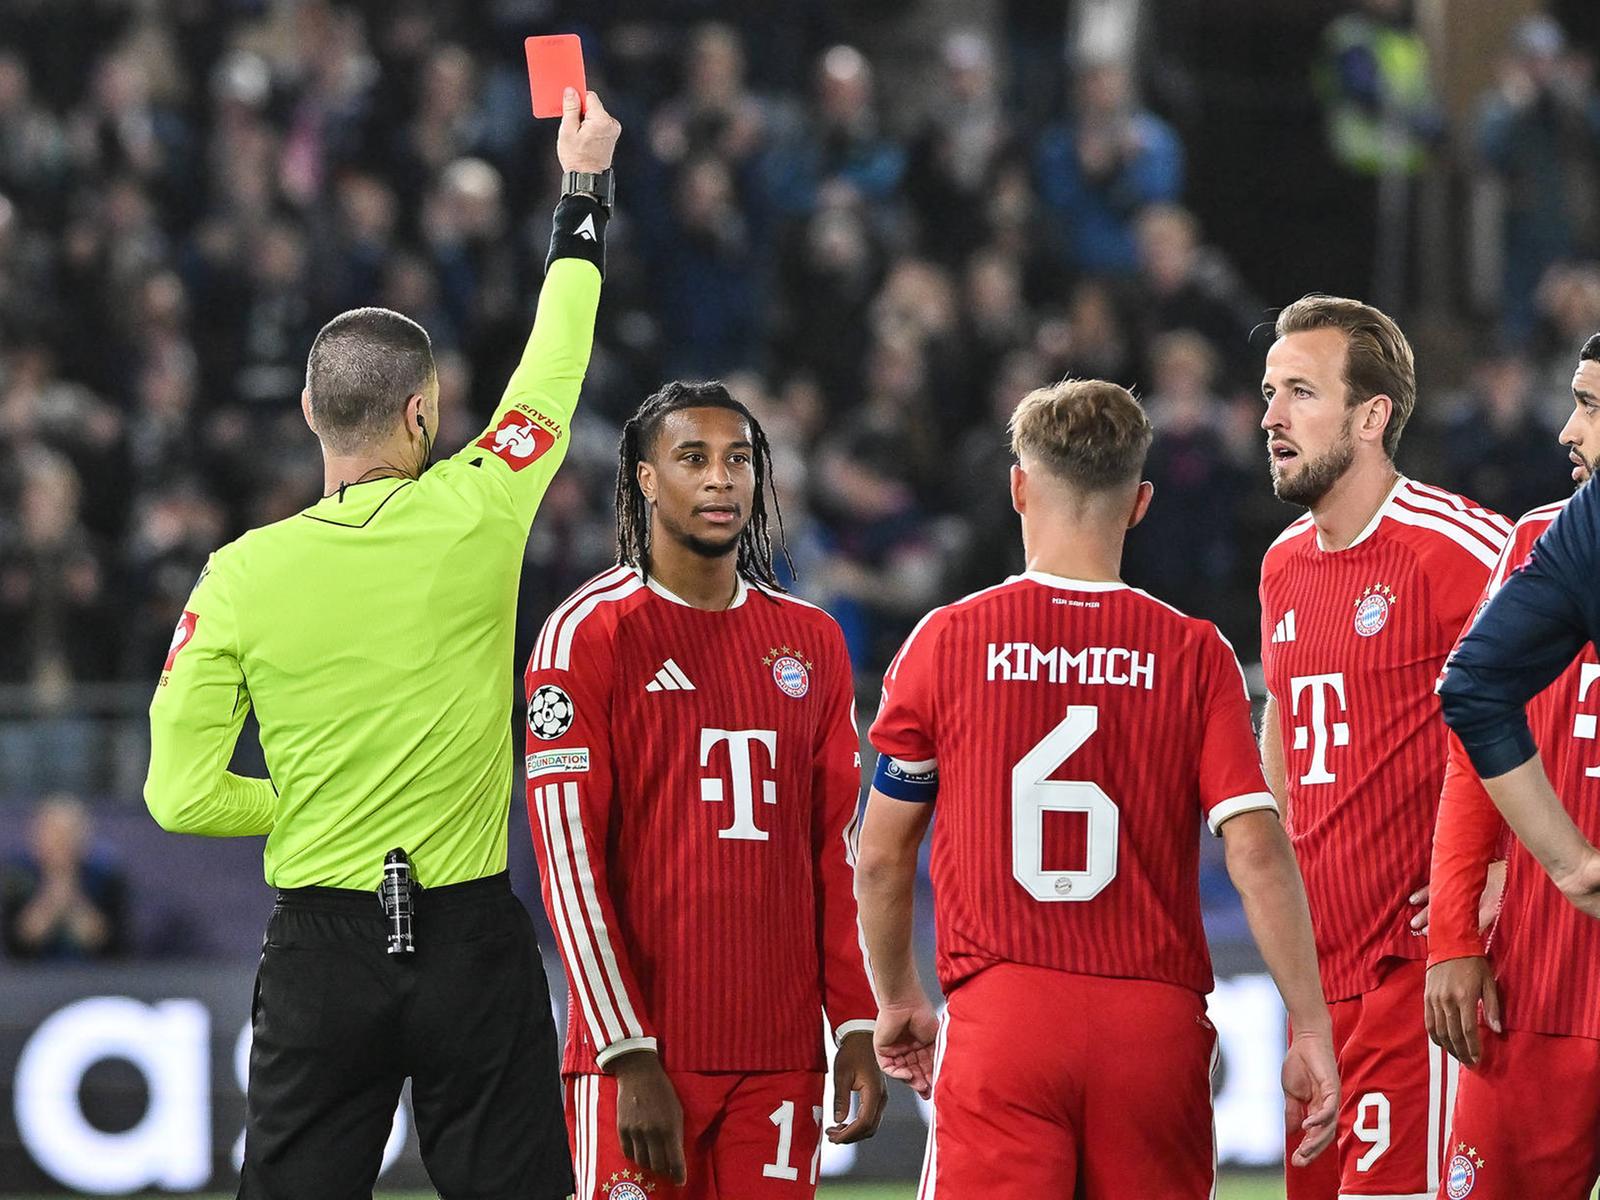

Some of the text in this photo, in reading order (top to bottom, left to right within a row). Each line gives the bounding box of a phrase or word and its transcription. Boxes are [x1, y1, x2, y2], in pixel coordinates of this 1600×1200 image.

[987, 643, 1155, 690] KIMMICH
[527, 755, 588, 769] FOUNDATION
[1012, 705, 1119, 902] 6
[1353, 1092, 1391, 1172] 9
